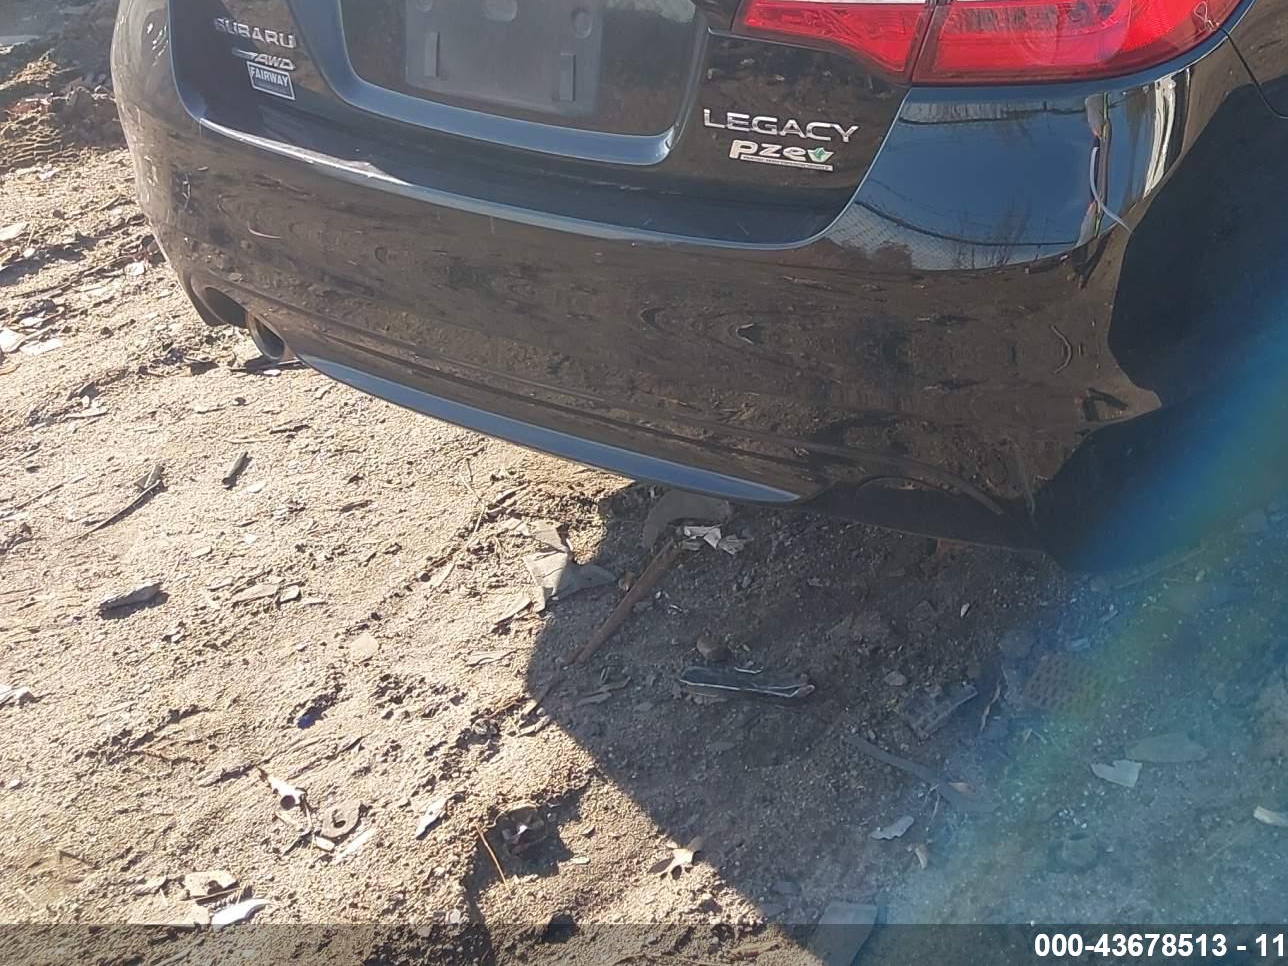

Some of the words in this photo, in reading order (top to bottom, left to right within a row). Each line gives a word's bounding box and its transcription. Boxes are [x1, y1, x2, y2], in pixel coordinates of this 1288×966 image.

[214, 18, 297, 49] SUBARU
[254, 53, 296, 71] AWD
[250, 66, 289, 87] FAIRWAY
[703, 108, 859, 143] LEGACY
